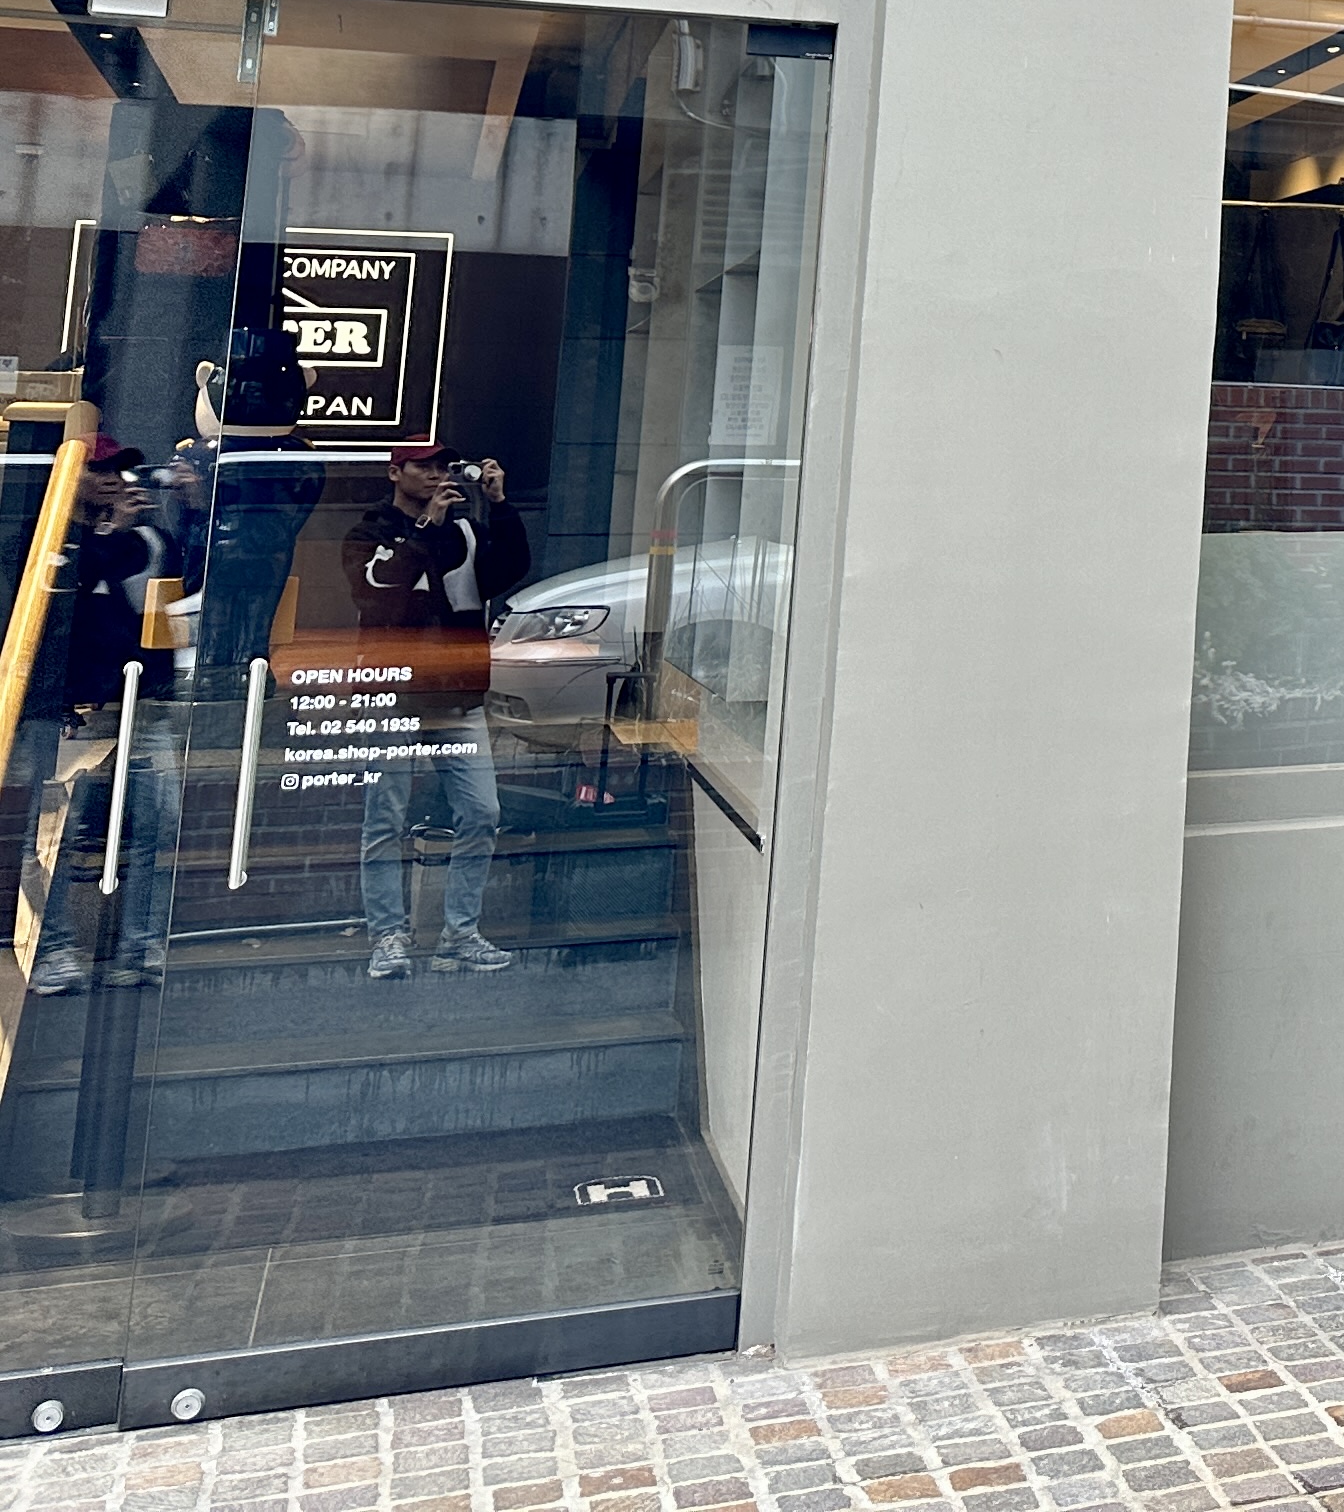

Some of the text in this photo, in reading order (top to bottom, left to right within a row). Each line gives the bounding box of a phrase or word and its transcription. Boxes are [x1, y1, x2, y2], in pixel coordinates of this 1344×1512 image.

[291, 666, 413, 685] OPEN HOURS
[290, 694, 336, 710] 12:00
[350, 692, 397, 708] 21:00
[287, 716, 421, 736] Tel. 02 540 1935
[284, 742, 478, 762] korea.shop-porter.com
[301, 771, 382, 789] porter_kr
